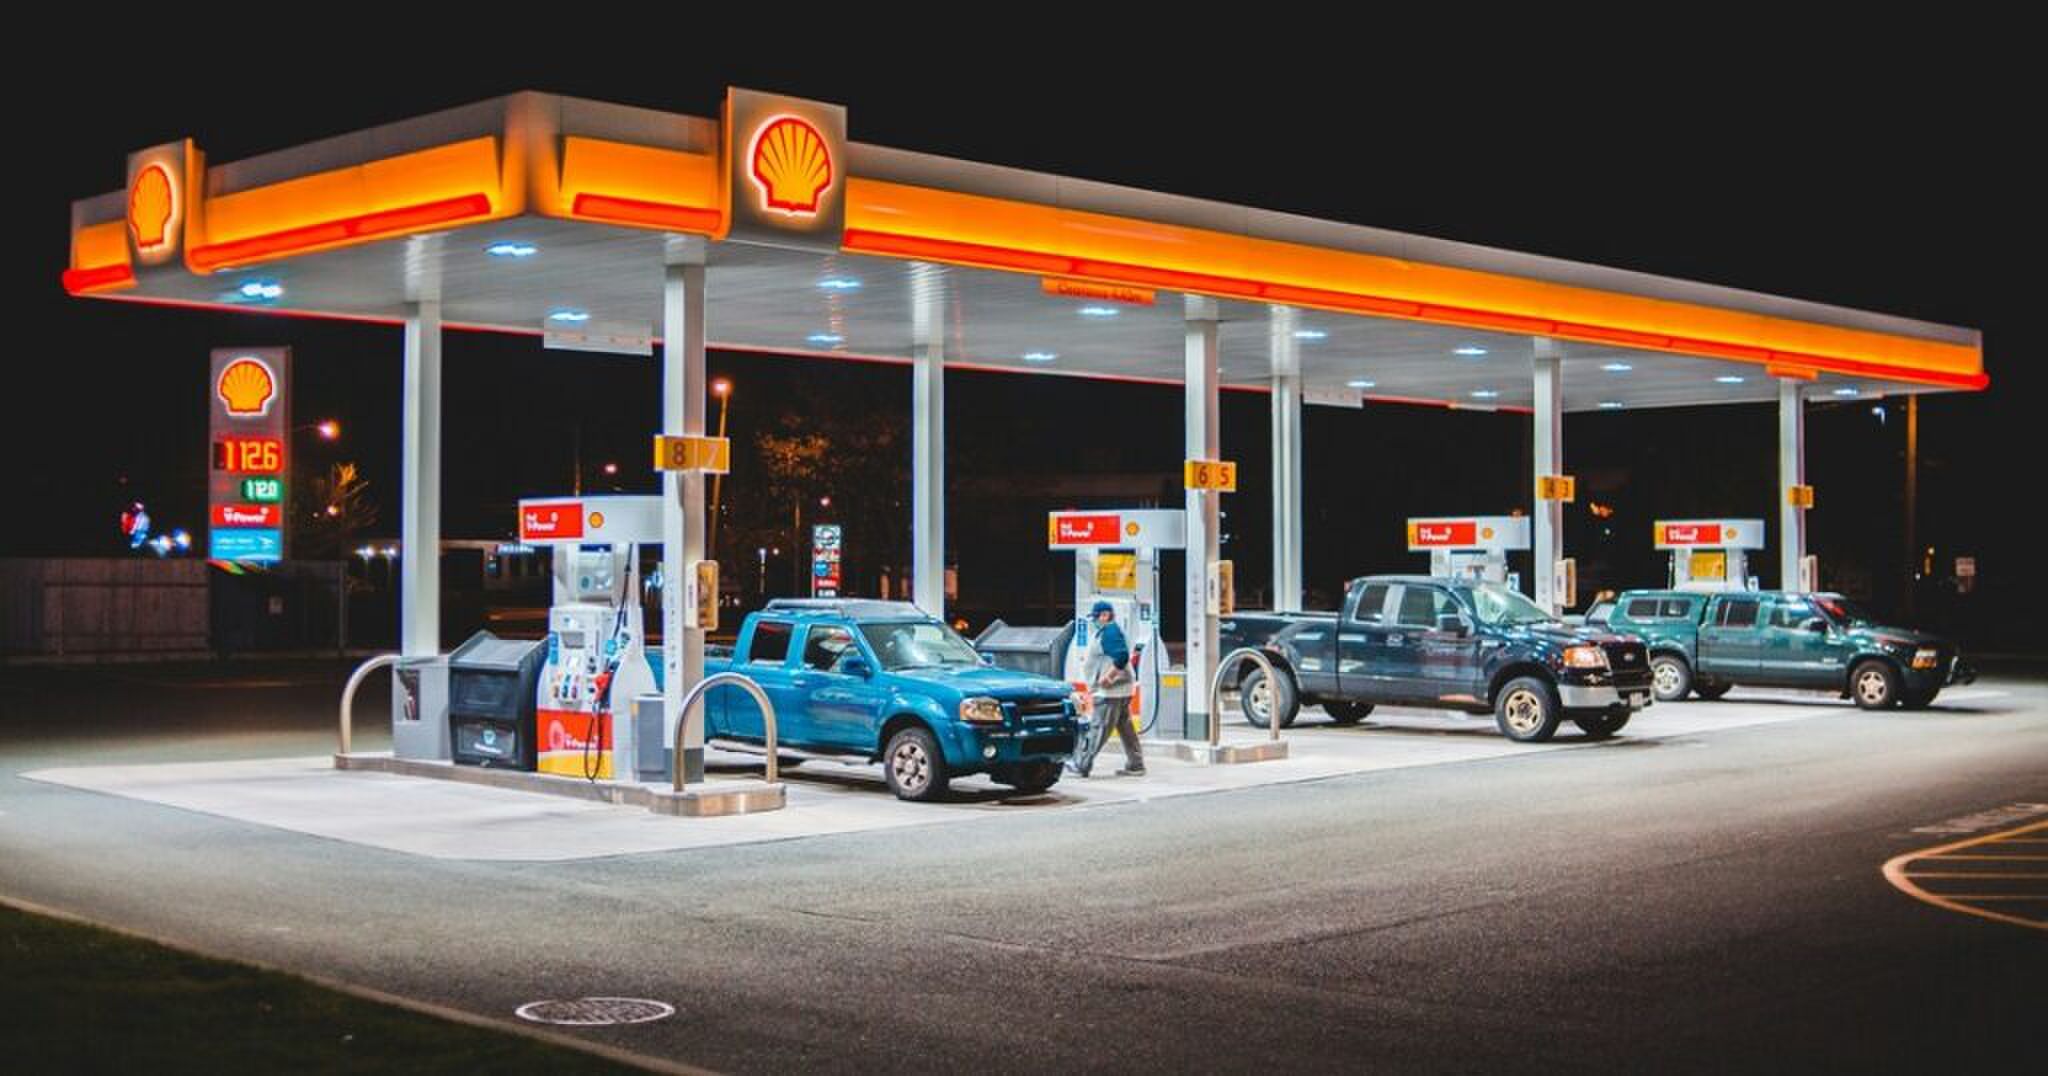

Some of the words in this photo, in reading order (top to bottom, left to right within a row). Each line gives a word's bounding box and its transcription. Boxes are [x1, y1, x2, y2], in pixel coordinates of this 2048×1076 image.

[673, 441, 686, 465] 8
[1199, 465, 1208, 485] 6
[1221, 466, 1230, 485] 5
